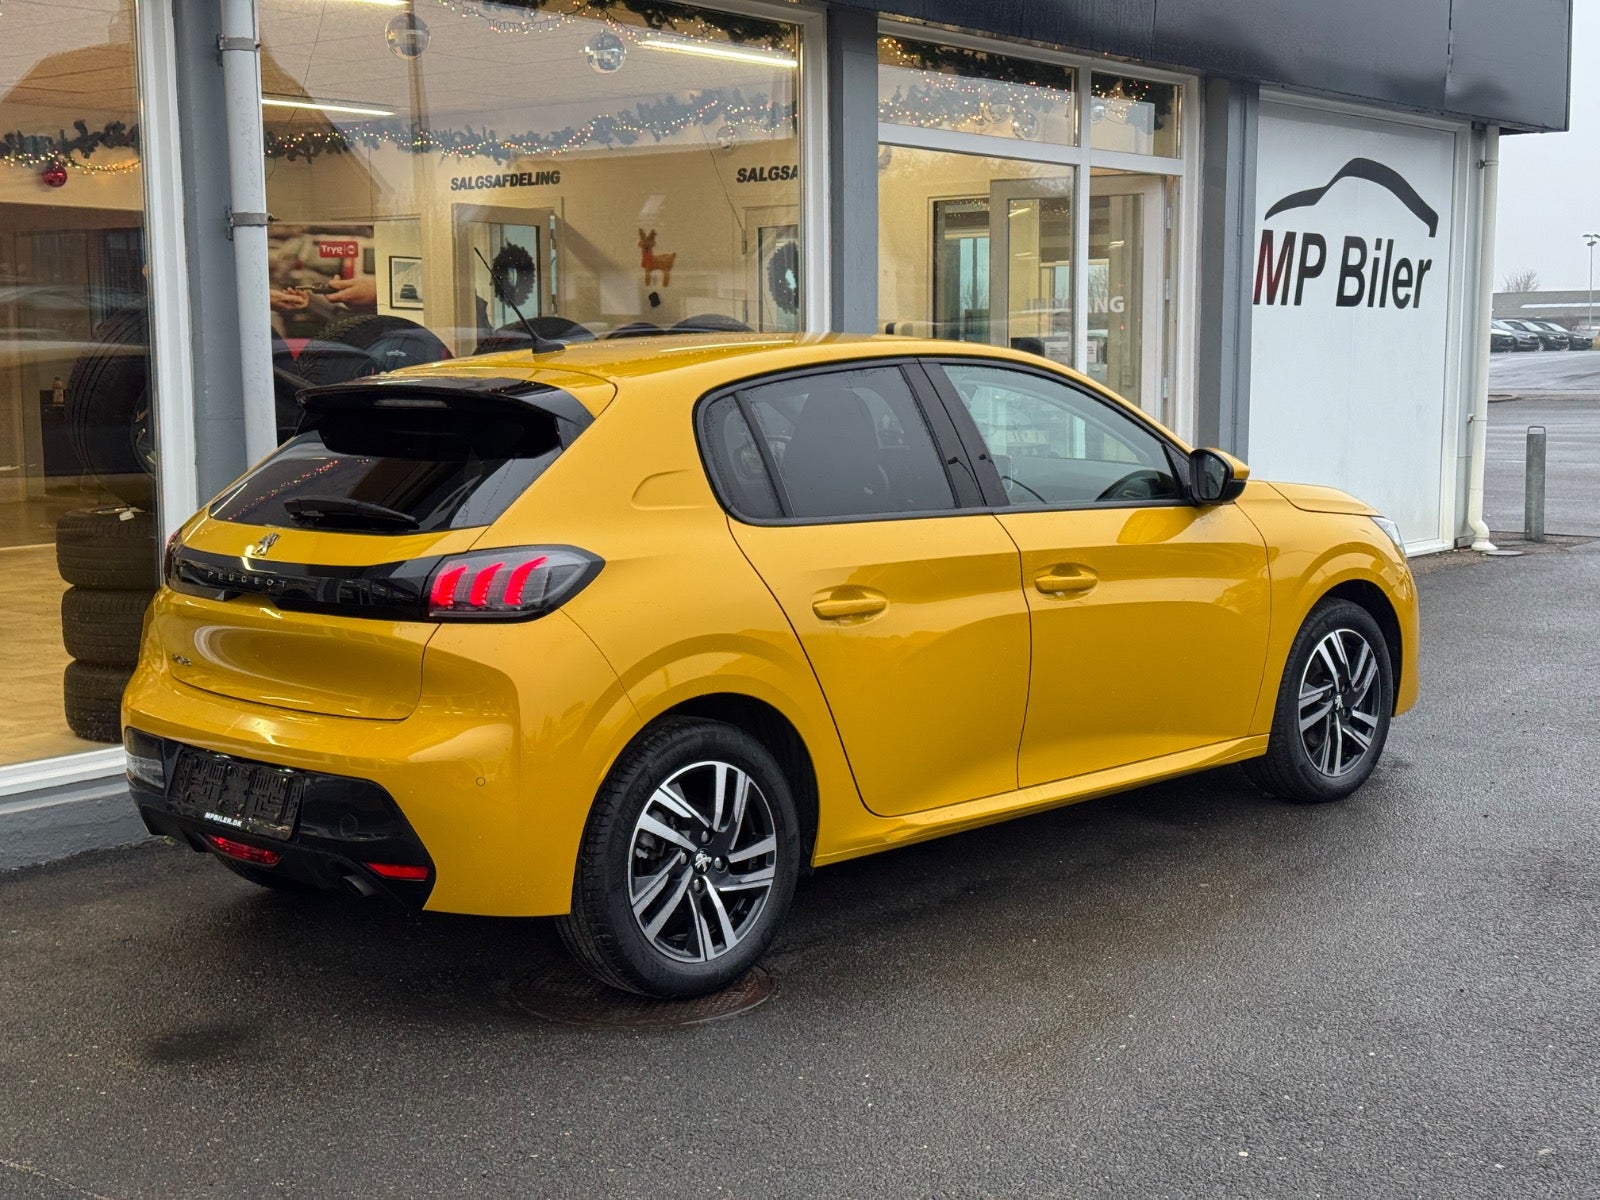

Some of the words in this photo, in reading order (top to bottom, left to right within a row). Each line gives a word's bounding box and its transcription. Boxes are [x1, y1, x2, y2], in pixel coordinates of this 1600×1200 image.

[450, 170, 561, 191] SALGSAFDELING
[321, 244, 344, 255] Tryg
[1253, 229, 1327, 306] MP
[1336, 235, 1432, 309] Biler
[207, 571, 287, 588] PEUGEOT
